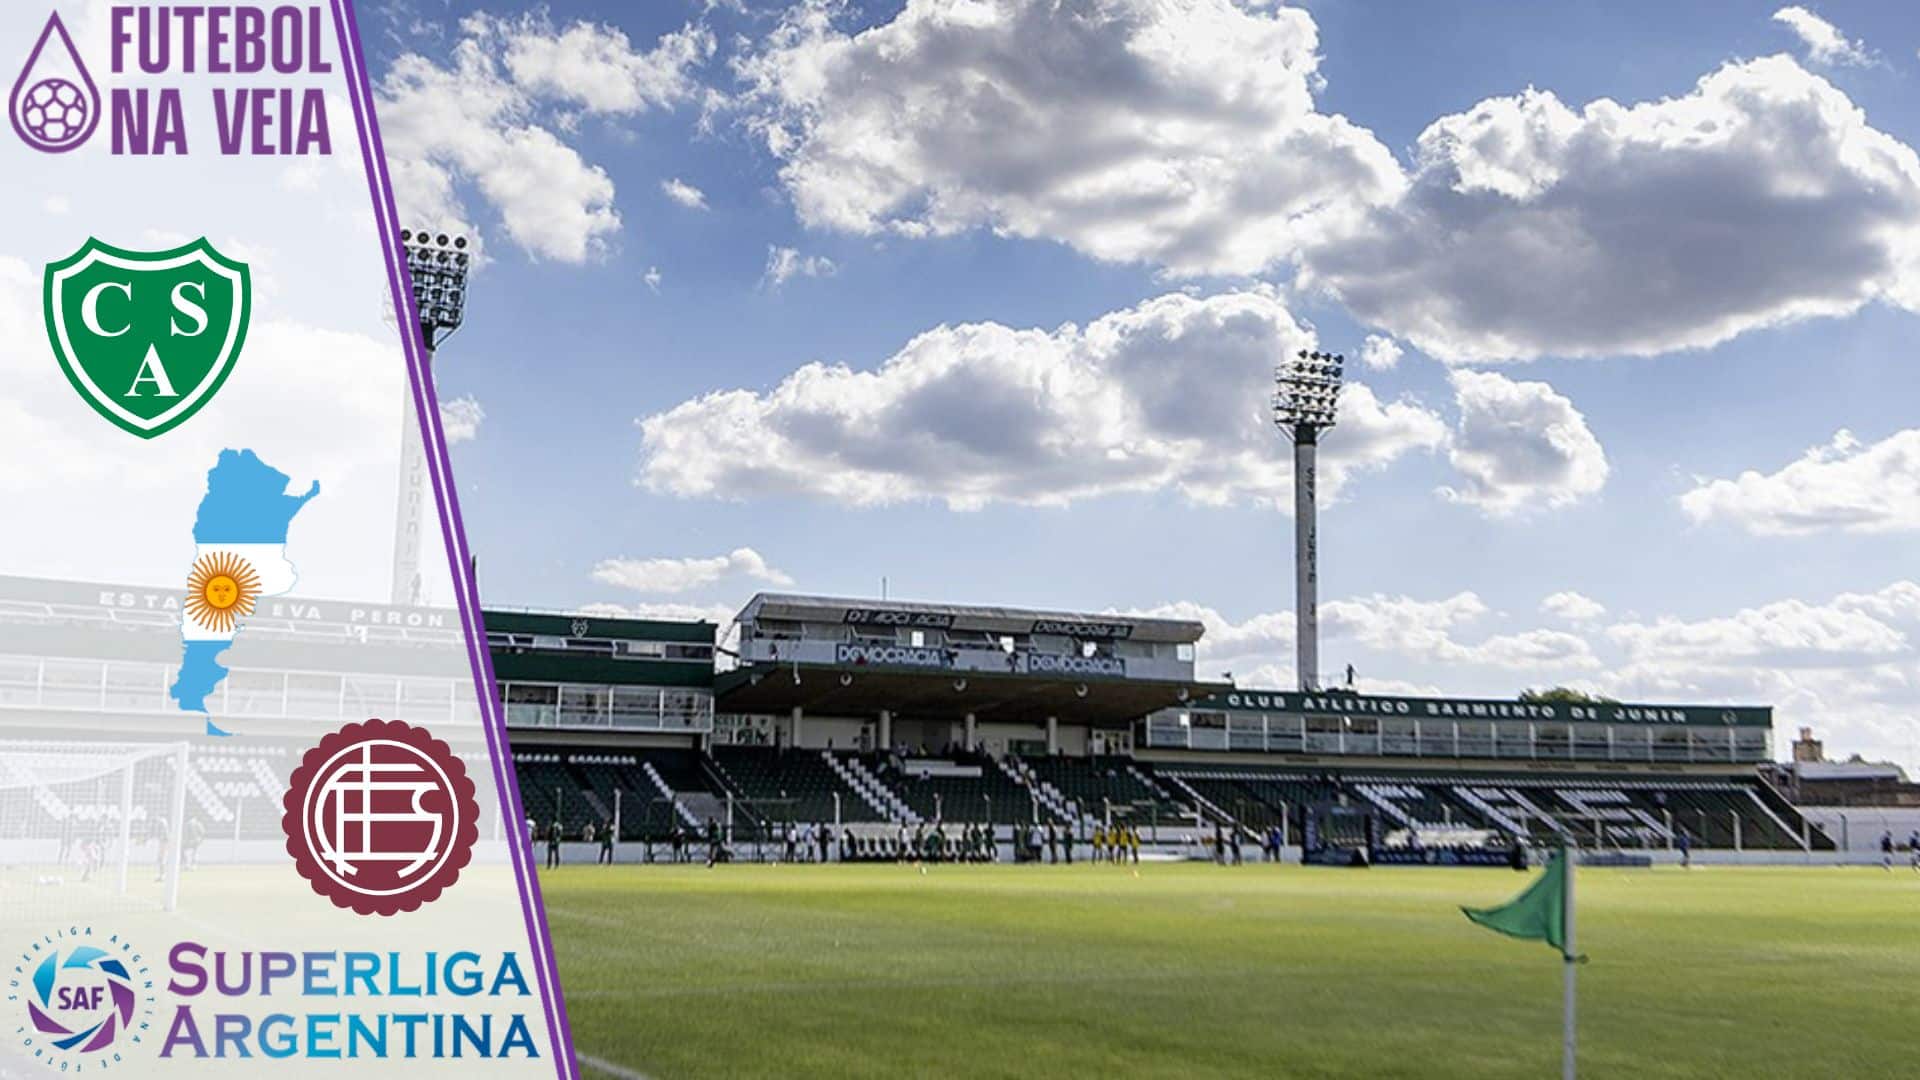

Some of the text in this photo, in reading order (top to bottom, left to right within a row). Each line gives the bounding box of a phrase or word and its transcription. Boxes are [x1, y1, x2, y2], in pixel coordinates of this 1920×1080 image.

[272, 604, 321, 620] EVA
[351, 609, 443, 627] PERON
[1227, 694, 1687, 723] CLUB ATLETICO SARMIENTO DE JUNIN
